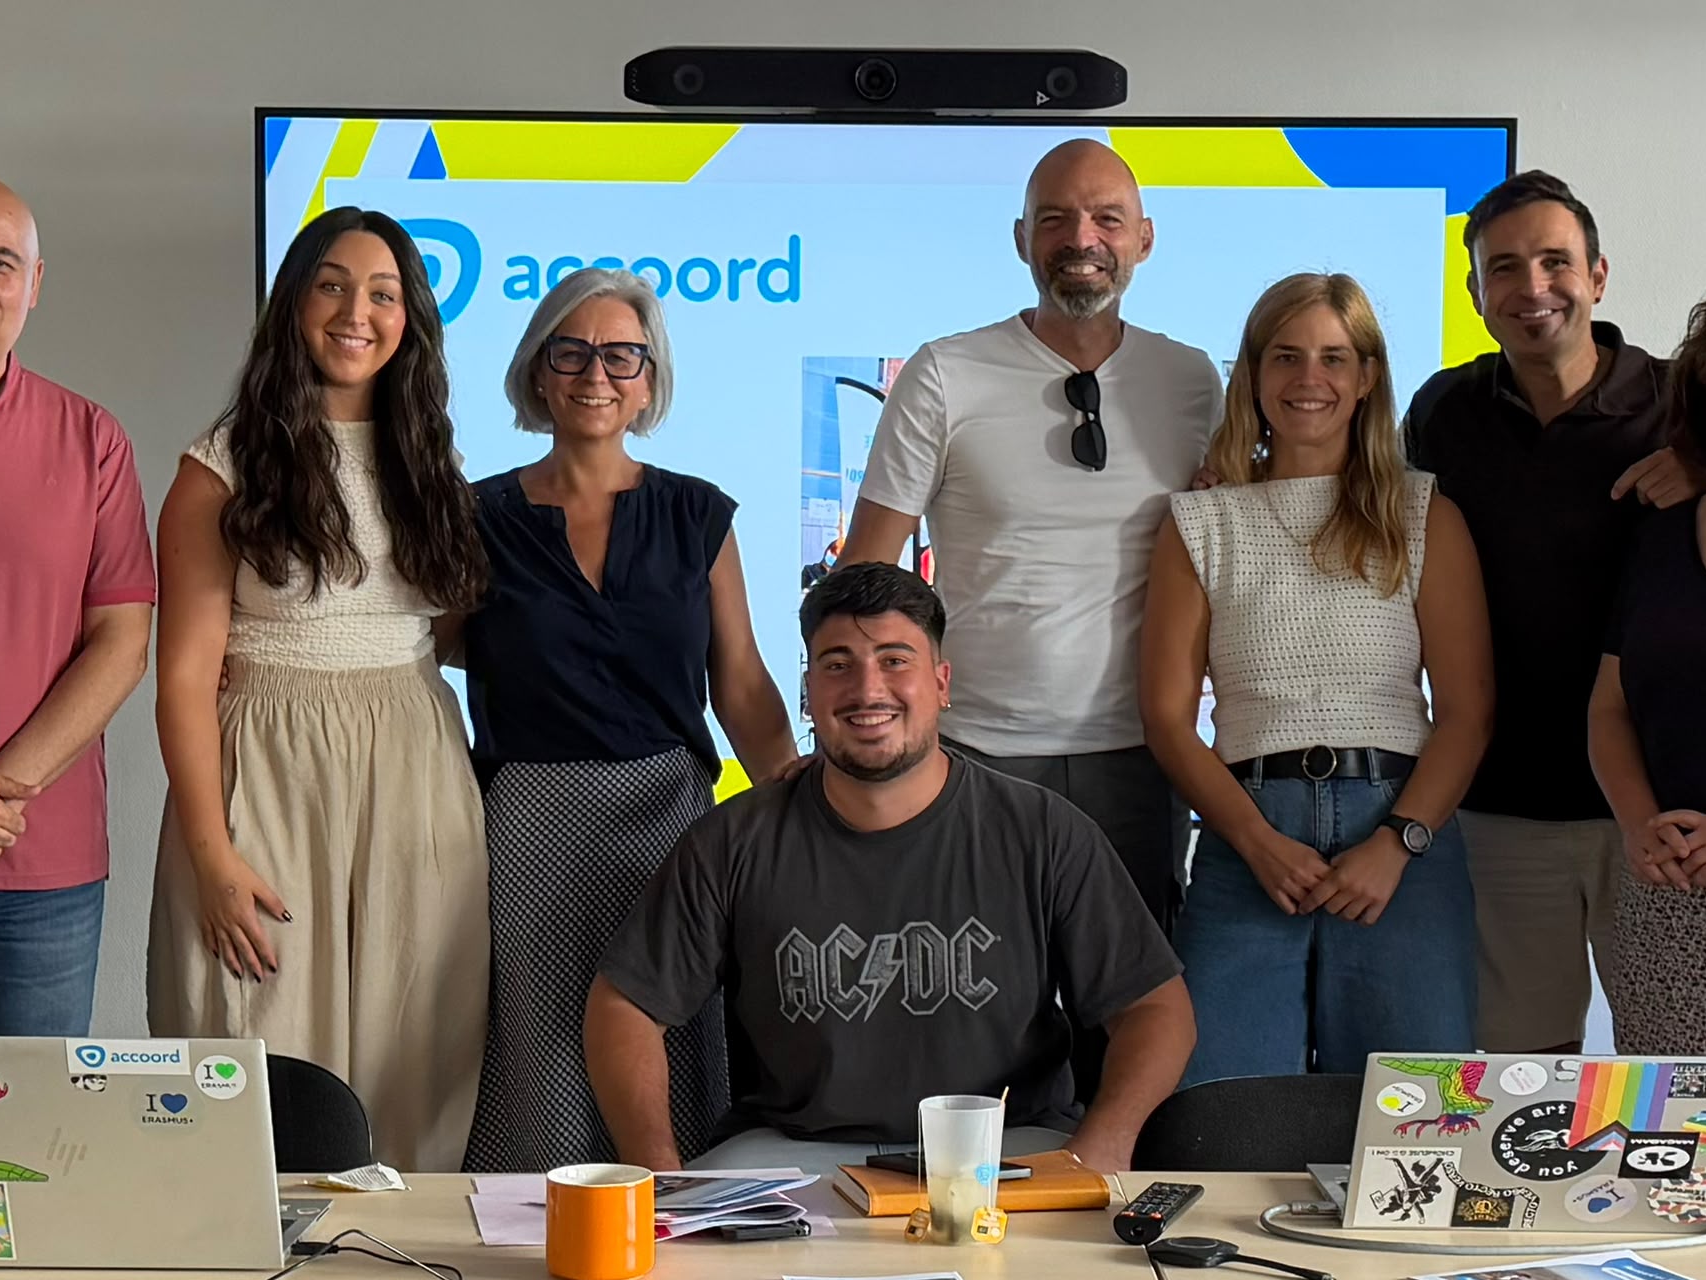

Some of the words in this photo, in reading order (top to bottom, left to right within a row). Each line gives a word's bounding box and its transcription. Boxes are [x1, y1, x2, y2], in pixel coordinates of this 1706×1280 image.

[110, 1048, 182, 1064] accoord
[1530, 1102, 1568, 1120] art
[1498, 1114, 1531, 1175] deserve
[1630, 1135, 1695, 1146] MACADAM
[1538, 1162, 1580, 1178] you
